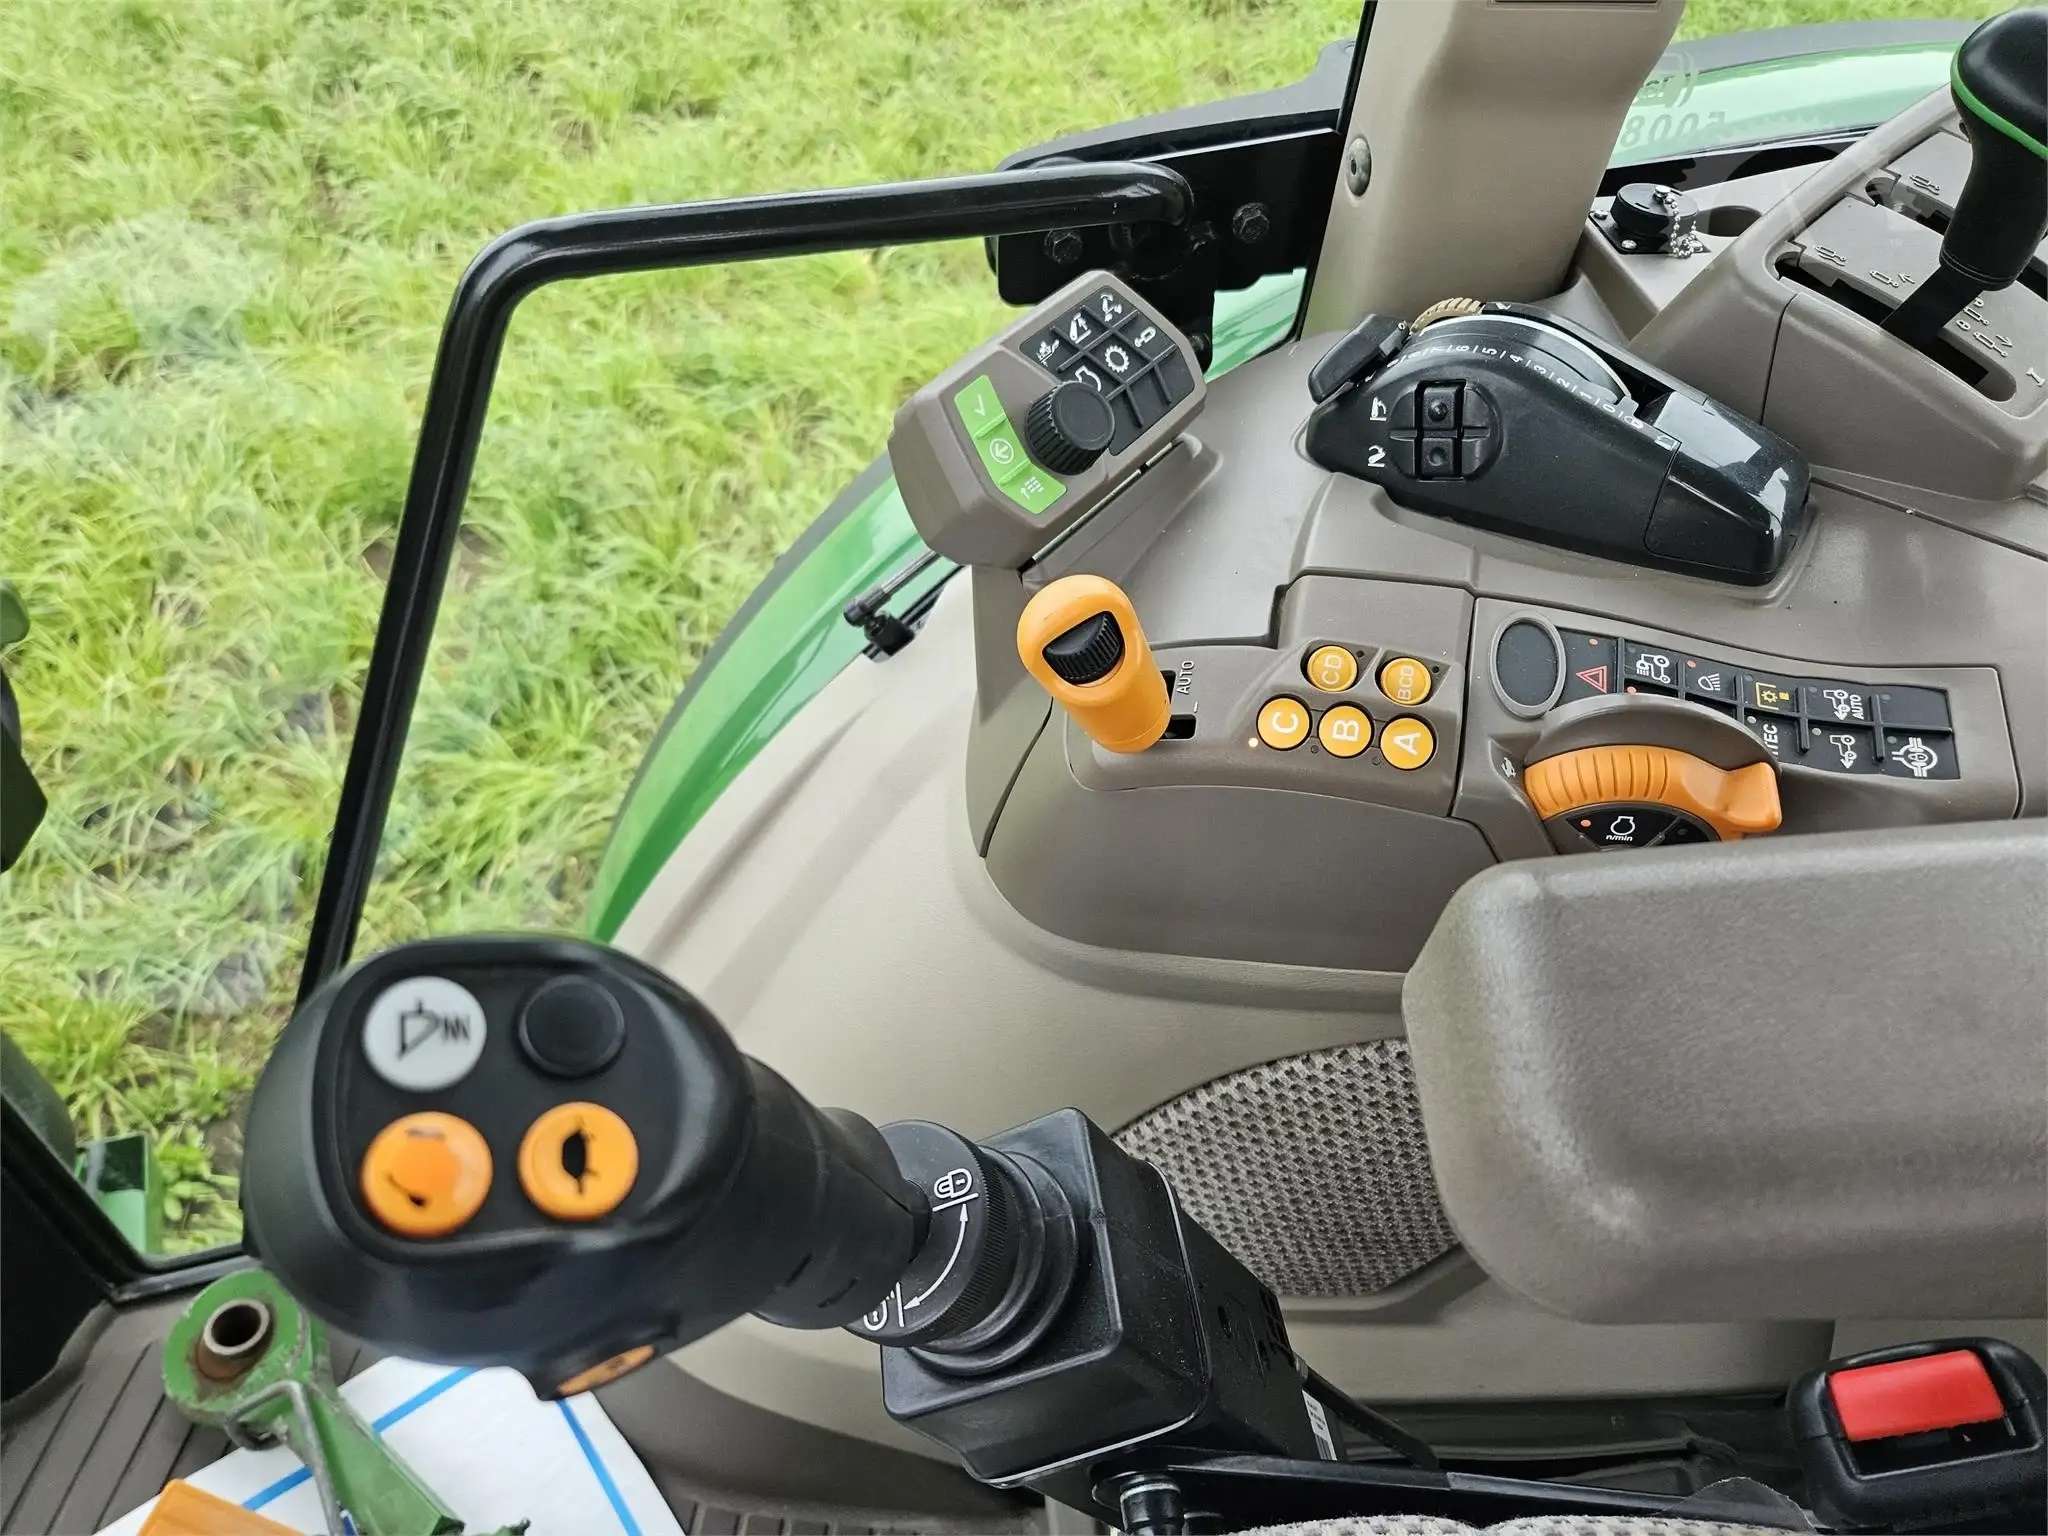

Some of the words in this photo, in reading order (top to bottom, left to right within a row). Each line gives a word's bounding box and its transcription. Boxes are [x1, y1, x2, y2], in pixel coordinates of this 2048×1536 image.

[1455, 344, 1468, 352] 6
[1481, 346, 1497, 355] 5
[1509, 353, 1523, 363] 4
[1533, 364, 1547, 375] 3
[1556, 377, 1571, 389] 2
[1602, 403, 1616, 414] 0
[1176, 660, 1195, 695] AUTO
[1321, 654, 1344, 685] CD
[1397, 664, 1415, 701] BCD
[1851, 694, 1865, 720] AUTO
[1271, 711, 1299, 734] C
[1331, 719, 1360, 742] B
[1393, 731, 1422, 756] A
[1605, 833, 1634, 842] n/min
